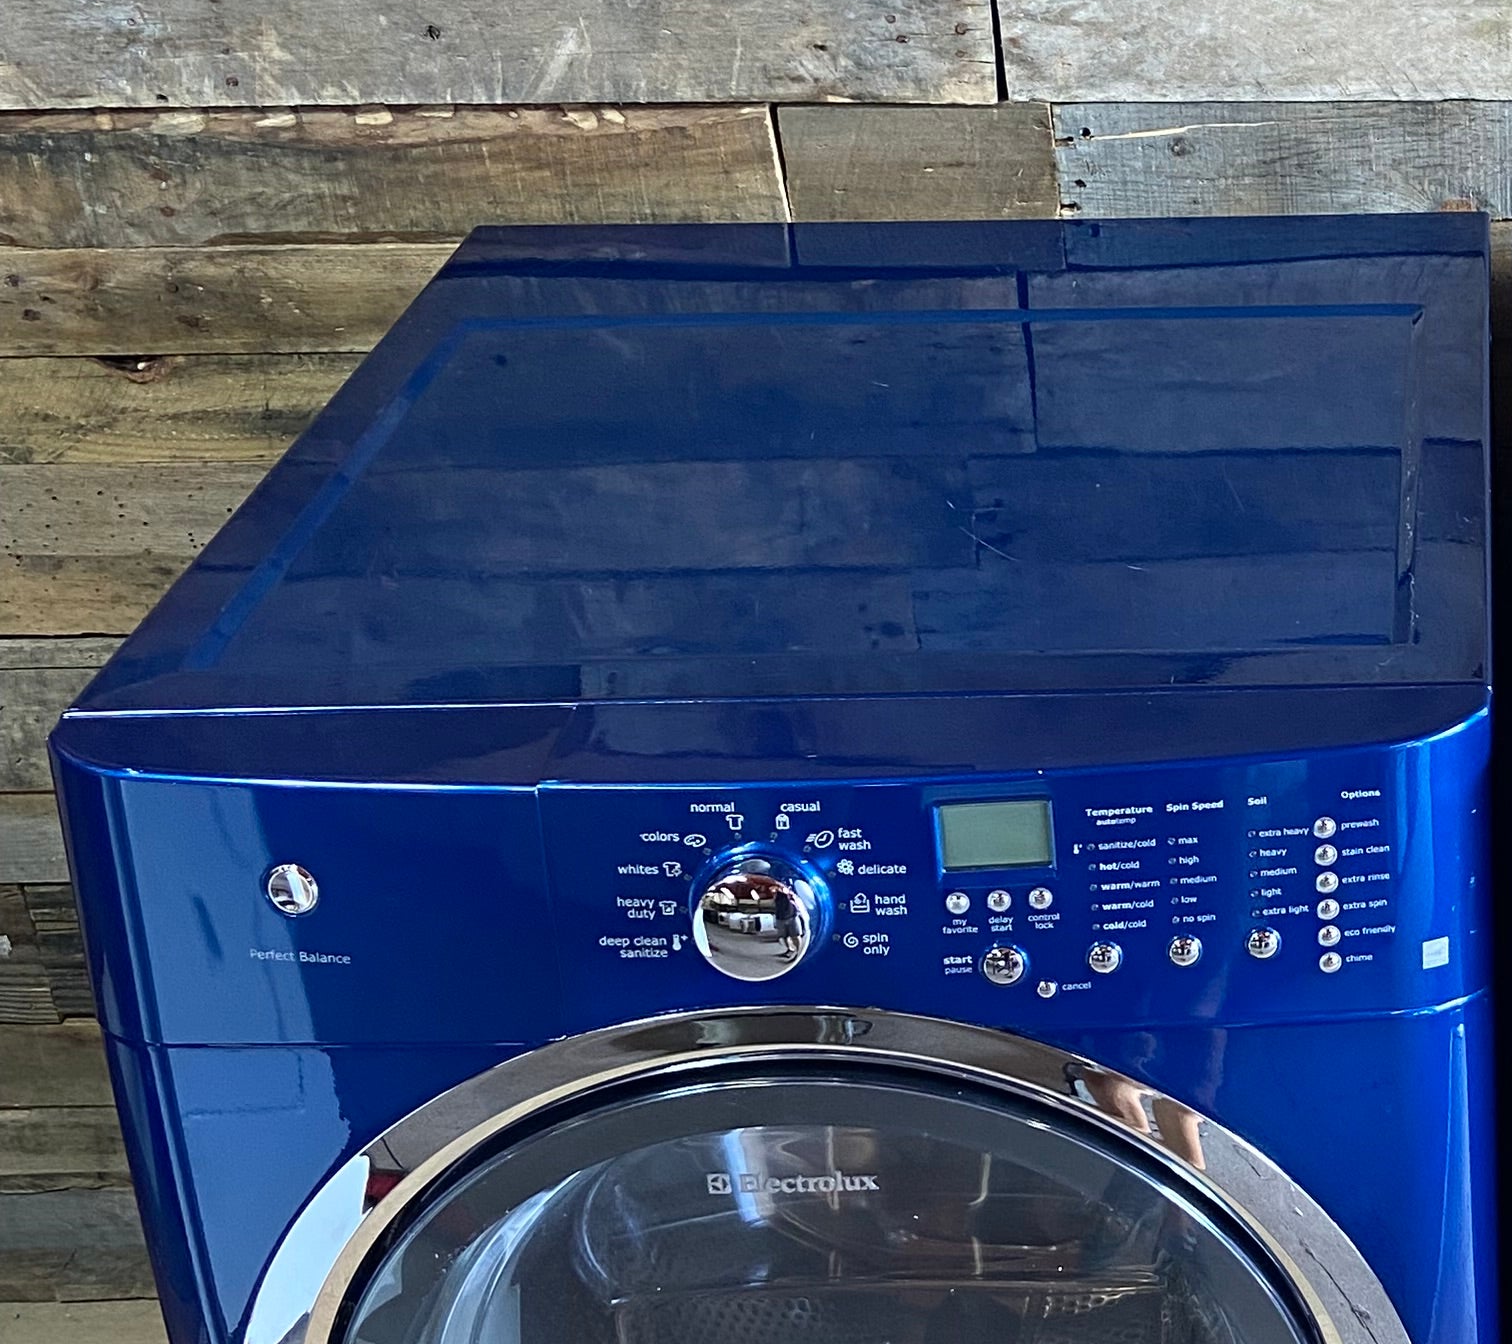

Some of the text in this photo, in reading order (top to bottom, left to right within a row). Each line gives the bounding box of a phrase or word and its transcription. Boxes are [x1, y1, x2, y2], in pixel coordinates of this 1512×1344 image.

[1341, 789, 1381, 800] Options
[780, 801, 820, 812] casual
[1166, 800, 1224, 813] Spin Speed
[1247, 797, 1267, 806] Soil
[690, 802, 735, 812] normal
[1085, 806, 1153, 817] Temperature
[1341, 818, 1379, 831] prewash
[641, 831, 680, 841] colors
[838, 828, 862, 838] fast
[1258, 827, 1309, 838] extra heavy
[838, 840, 871, 850] wash
[1098, 839, 1156, 850] sanitize/cold
[1178, 836, 1198, 845] max
[1259, 848, 1287, 857] heavy
[1342, 844, 1390, 857] stain clean
[1179, 855, 1200, 866] high
[617, 864, 659, 875] whites
[857, 864, 907, 874] delicate
[1099, 861, 1140, 871] hot/cold
[1260, 867, 1297, 877] medium
[1180, 875, 1217, 884] medium
[1342, 872, 1390, 884] extra rinse
[1100, 880, 1160, 891] warm/warm
[1261, 888, 1282, 898] light
[616, 897, 655, 908] heavy
[874, 894, 906, 904] hand
[1181, 896, 1197, 904] low
[1102, 900, 1154, 911] warm/cold
[1343, 898, 1387, 911] extra spin
[627, 908, 656, 920] duty
[875, 905, 907, 915] wash
[1262, 904, 1309, 916] extra light
[952, 918, 967, 927] my
[988, 916, 1014, 925] delay
[1028, 913, 1060, 922] control
[1183, 913, 1216, 923] no spin
[942, 926, 979, 934] favorite
[991, 924, 1012, 932] start
[1035, 921, 1054, 929] lock
[1103, 920, 1147, 930] cold/cold
[1344, 925, 1396, 937] eco friendly
[599, 936, 667, 947] deep clean
[862, 933, 888, 944] spin
[620, 948, 668, 958] sanitize
[863, 944, 890, 956] only
[250, 948, 351, 964] Perfect Balance
[943, 955, 973, 965] start
[1346, 954, 1373, 963] chime
[944, 966, 972, 975] pause
[1062, 981, 1091, 991] cancel
[740, 1171, 880, 1193] Electrolux
